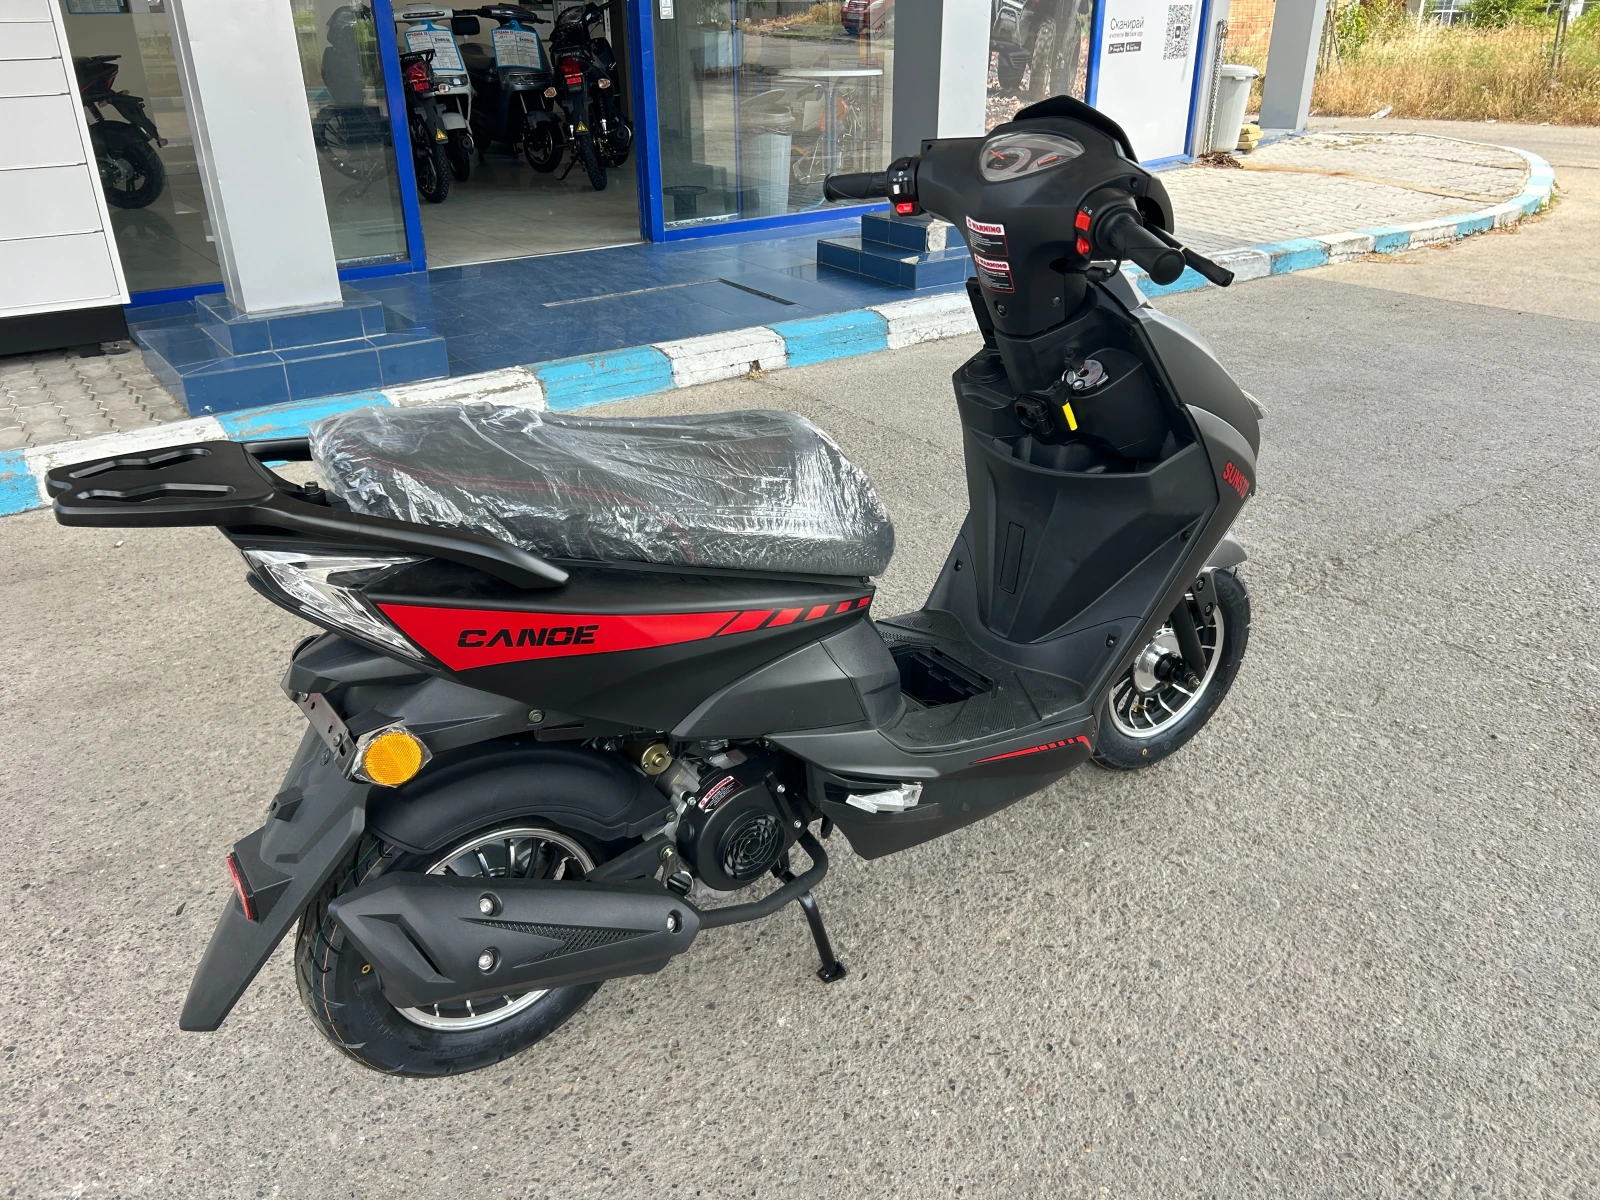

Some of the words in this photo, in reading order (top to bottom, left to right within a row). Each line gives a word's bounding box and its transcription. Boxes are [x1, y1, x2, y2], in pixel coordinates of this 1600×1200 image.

[1110, 16, 1144, 31] Сканирай
[972, 223, 1002, 234] WARNING
[980, 259, 1007, 269] WARNING
[457, 624, 600, 648] CANOE
[705, 777, 731, 799] WARNING
